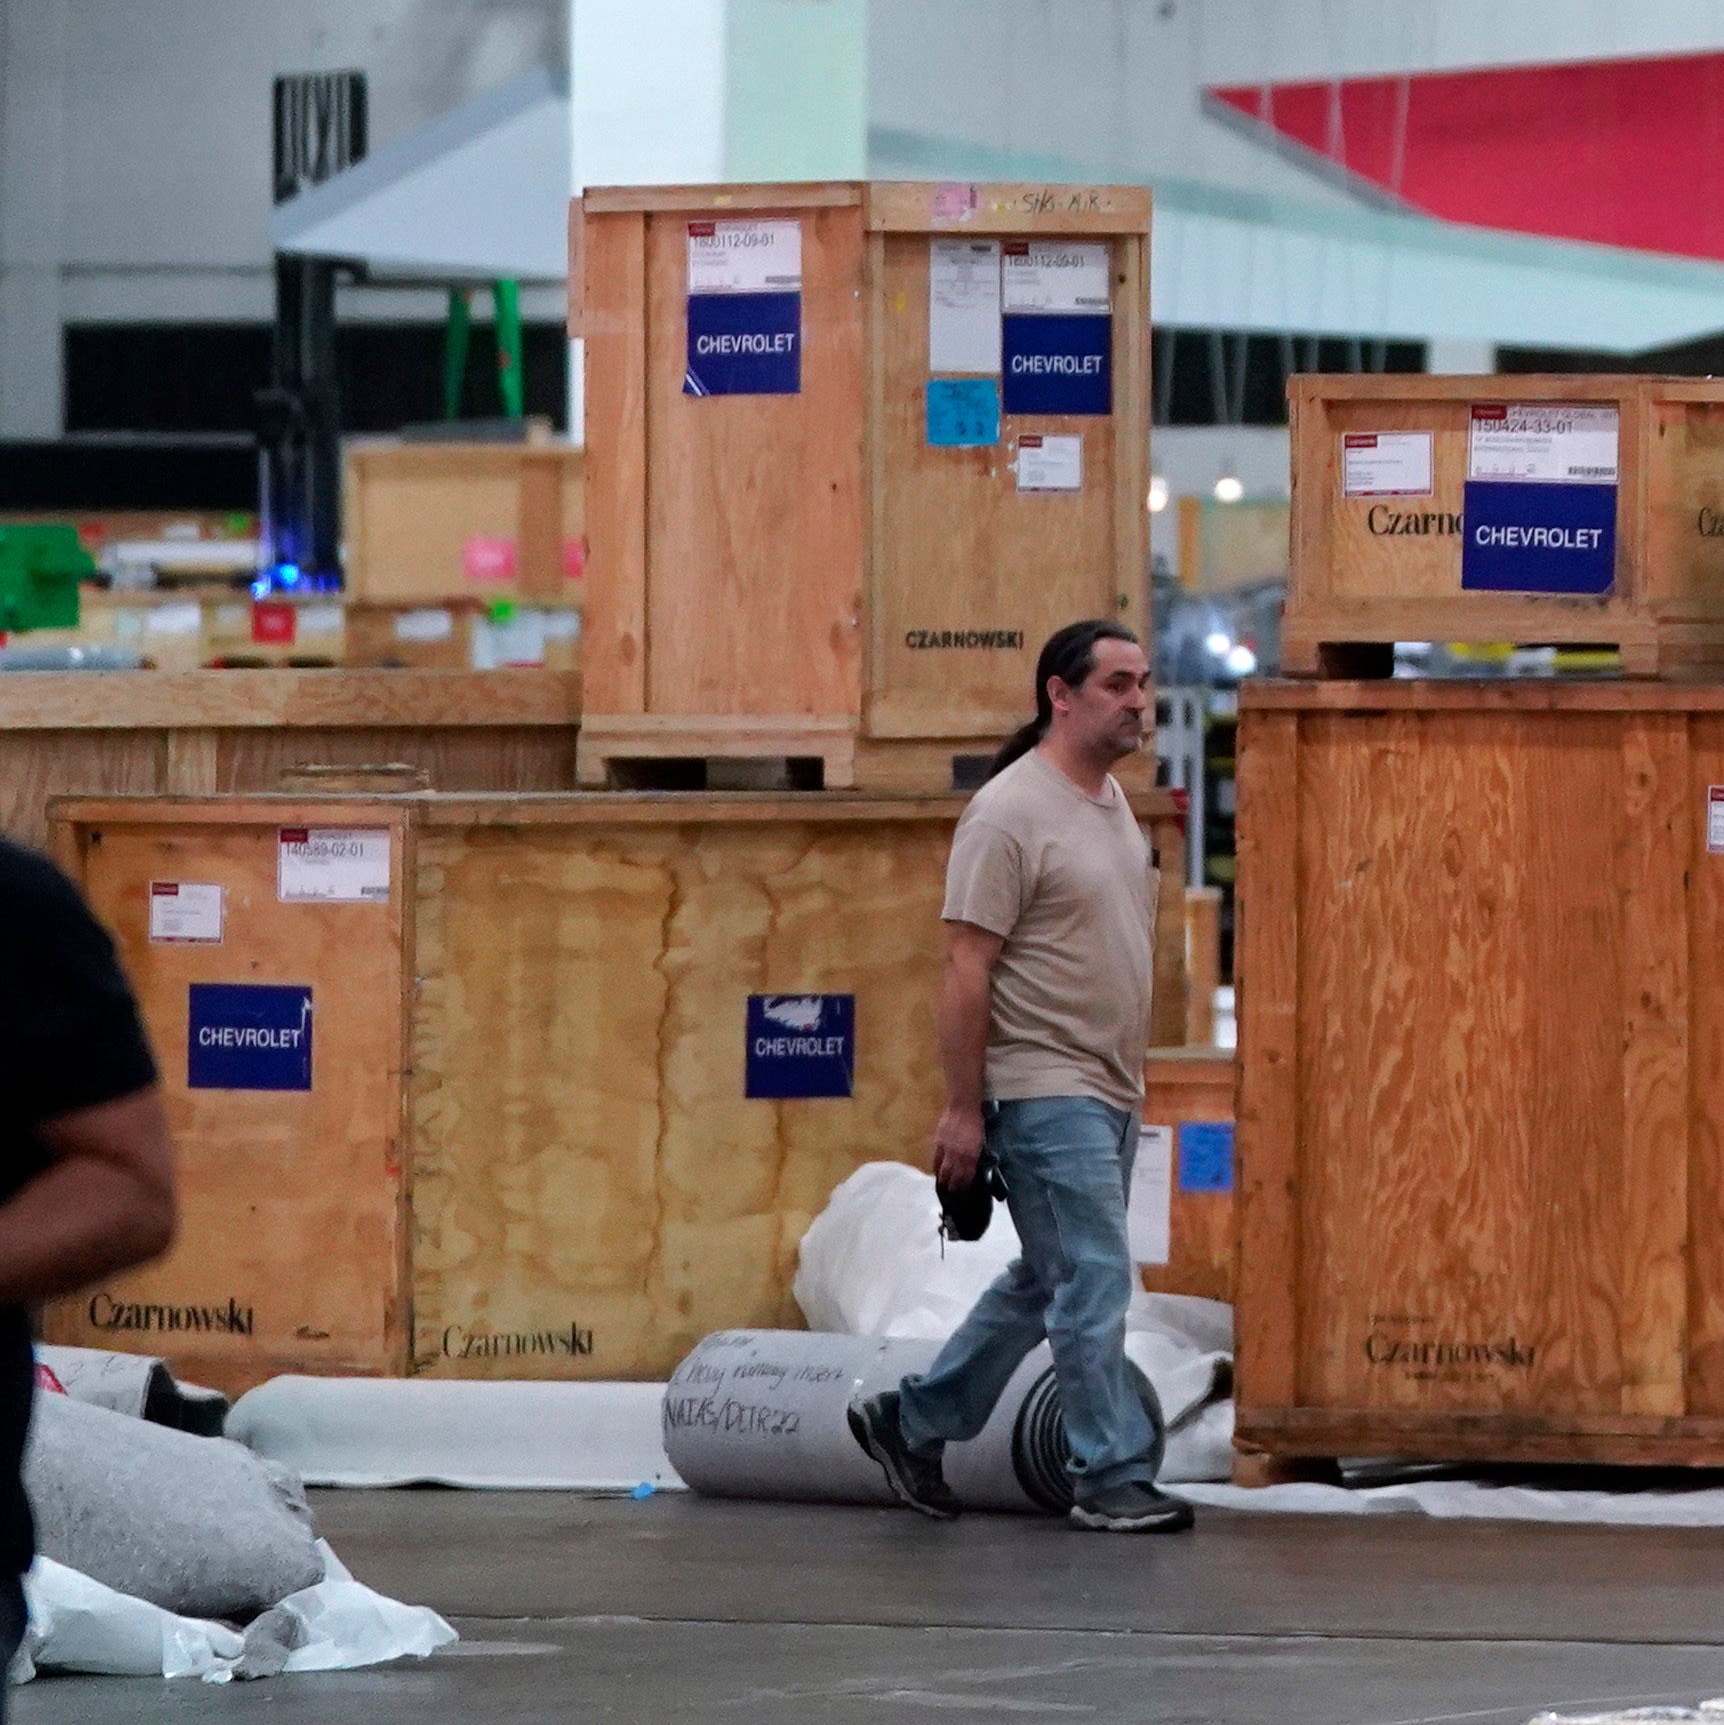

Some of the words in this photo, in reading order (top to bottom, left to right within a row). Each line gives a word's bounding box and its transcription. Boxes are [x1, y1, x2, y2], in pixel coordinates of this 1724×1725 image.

[696, 333, 796, 356] CHEVROLET
[1011, 354, 1104, 375] CHEVROLET
[1474, 524, 1603, 550] CHEVROLET
[904, 628, 1025, 651] CZARNOWSKI
[198, 1026, 302, 1049] CHEVROLET
[754, 1036, 845, 1056] CHEVROLET
[87, 1292, 255, 1337] Czarnowski
[442, 1321, 596, 1361] Czarnowski
[1364, 1331, 1537, 1370] Czarnowski
